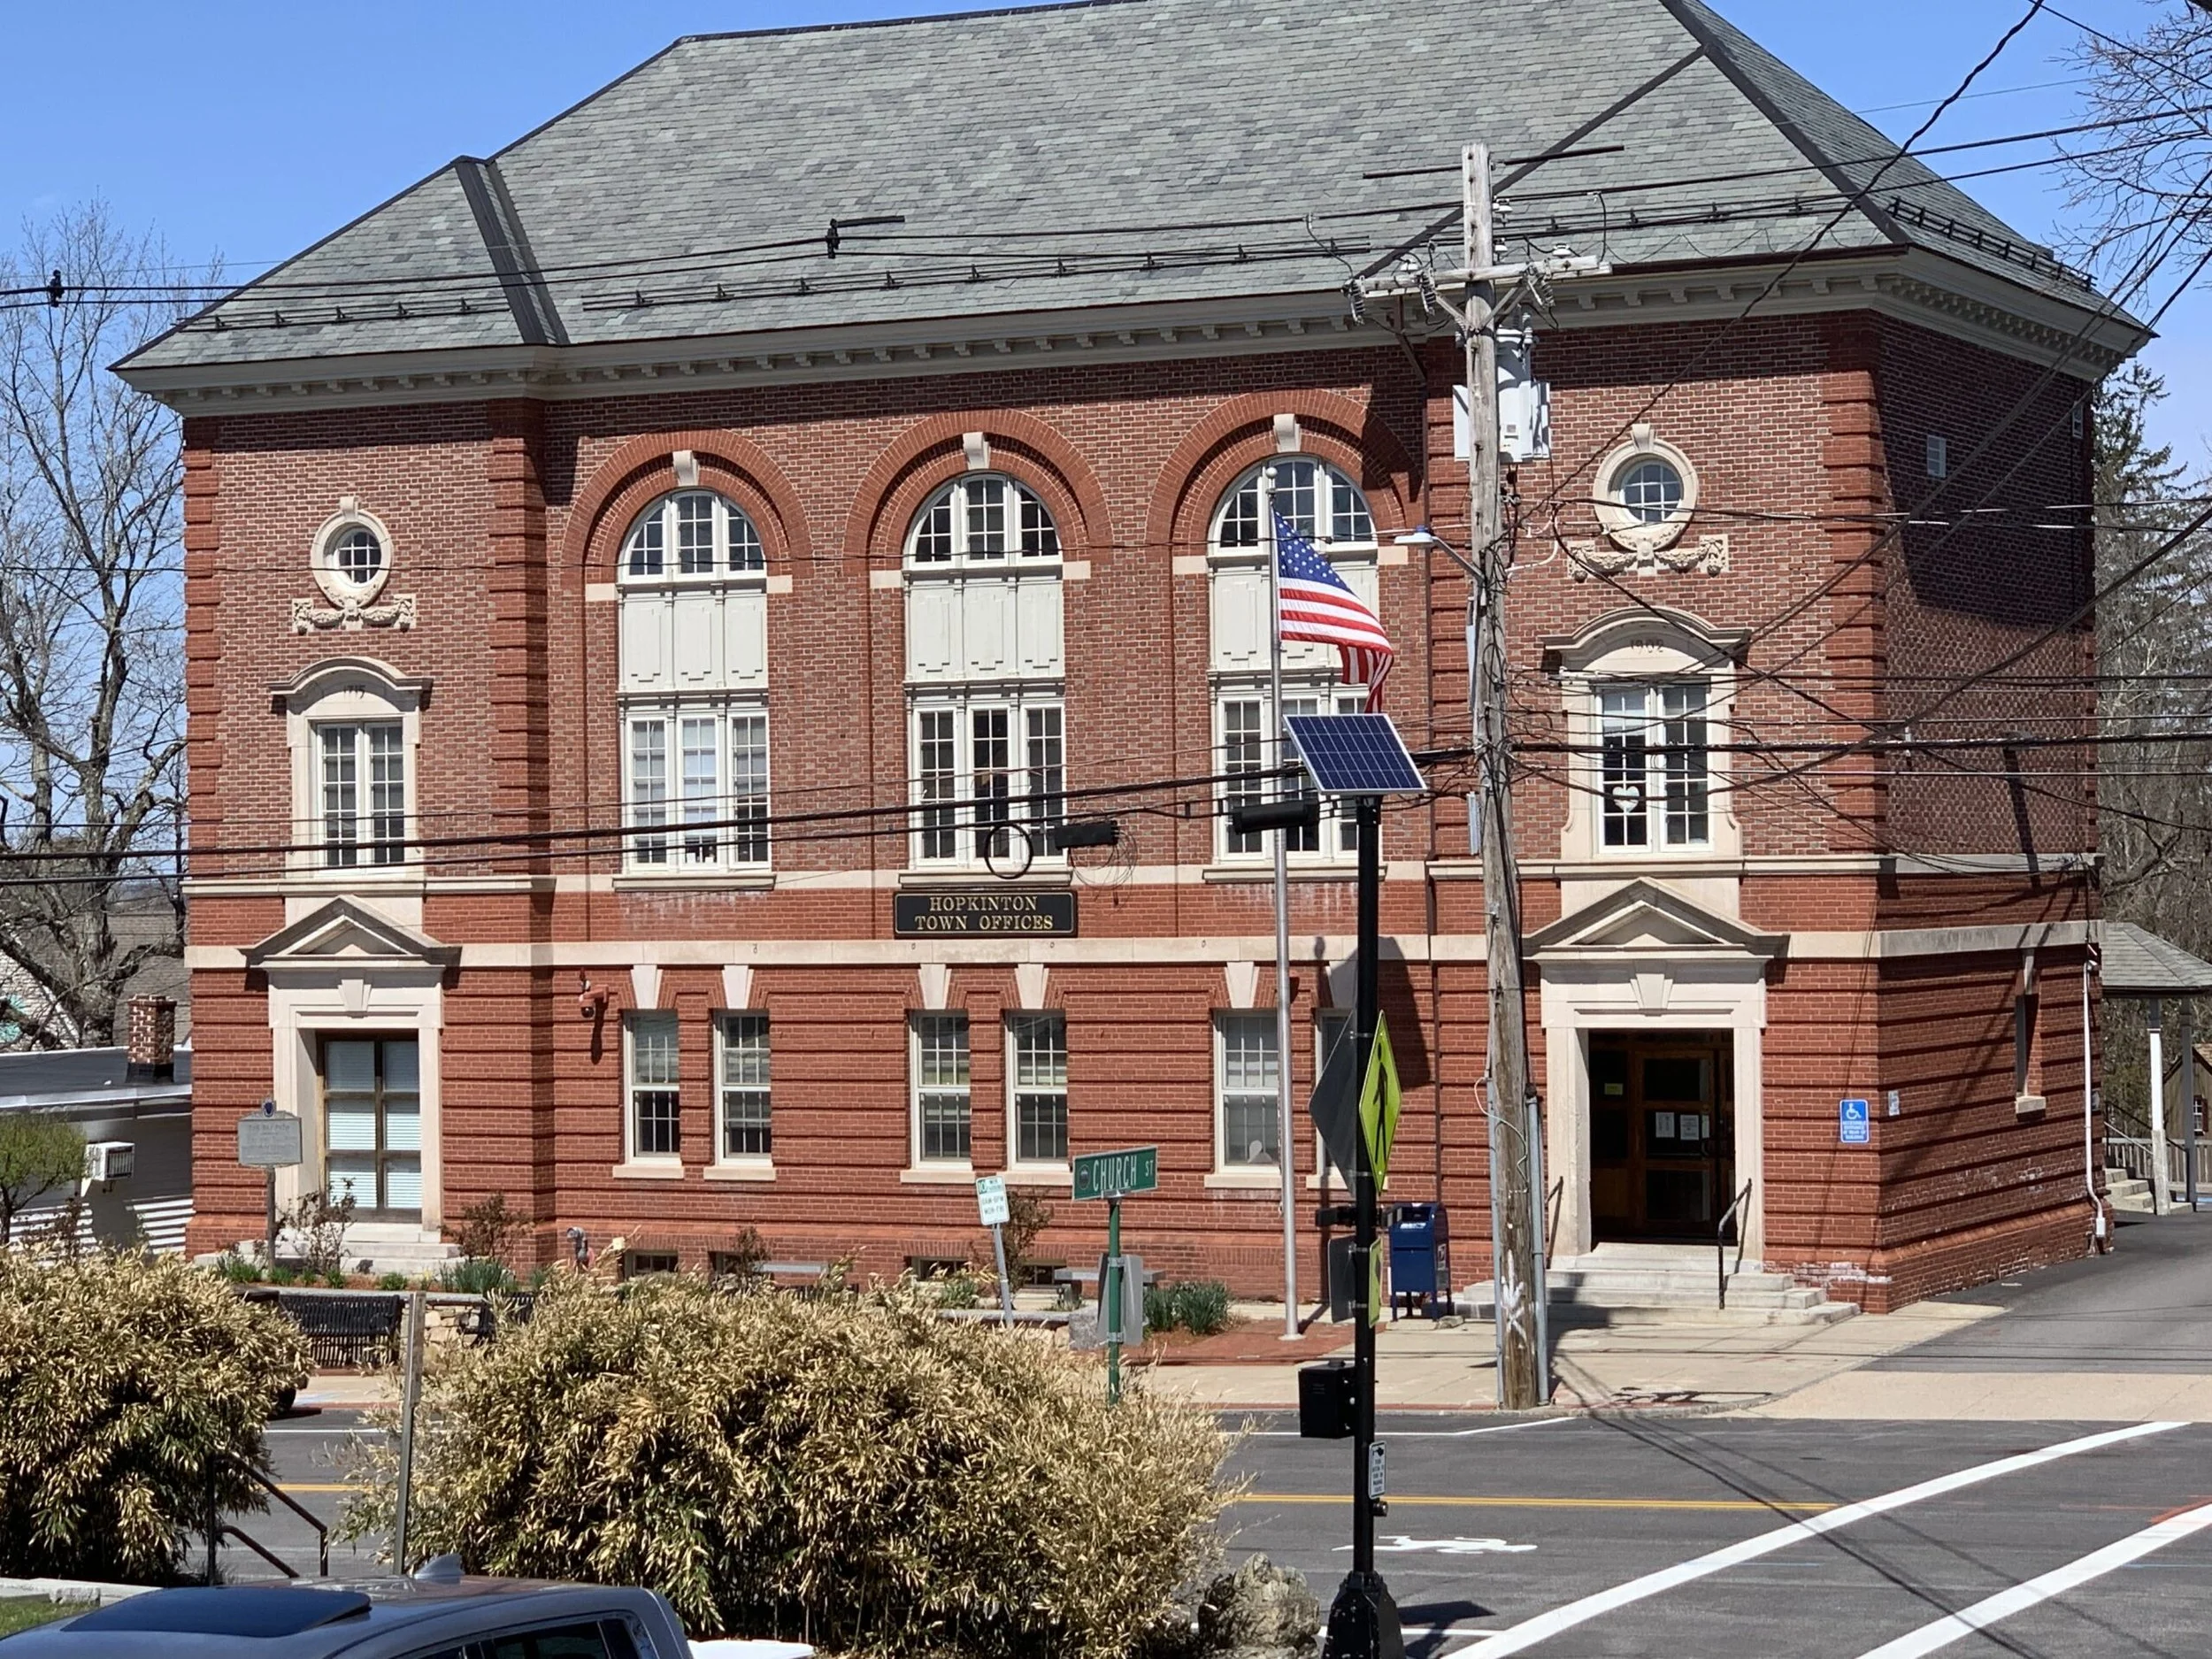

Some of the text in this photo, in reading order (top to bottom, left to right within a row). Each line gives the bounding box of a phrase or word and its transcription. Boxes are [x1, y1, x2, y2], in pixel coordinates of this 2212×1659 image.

[929, 895, 1038, 911] HOPKINTON
[914, 914, 1055, 931] TOWN OFFICES
[1092, 1155, 1155, 1192] CHURCH ST
